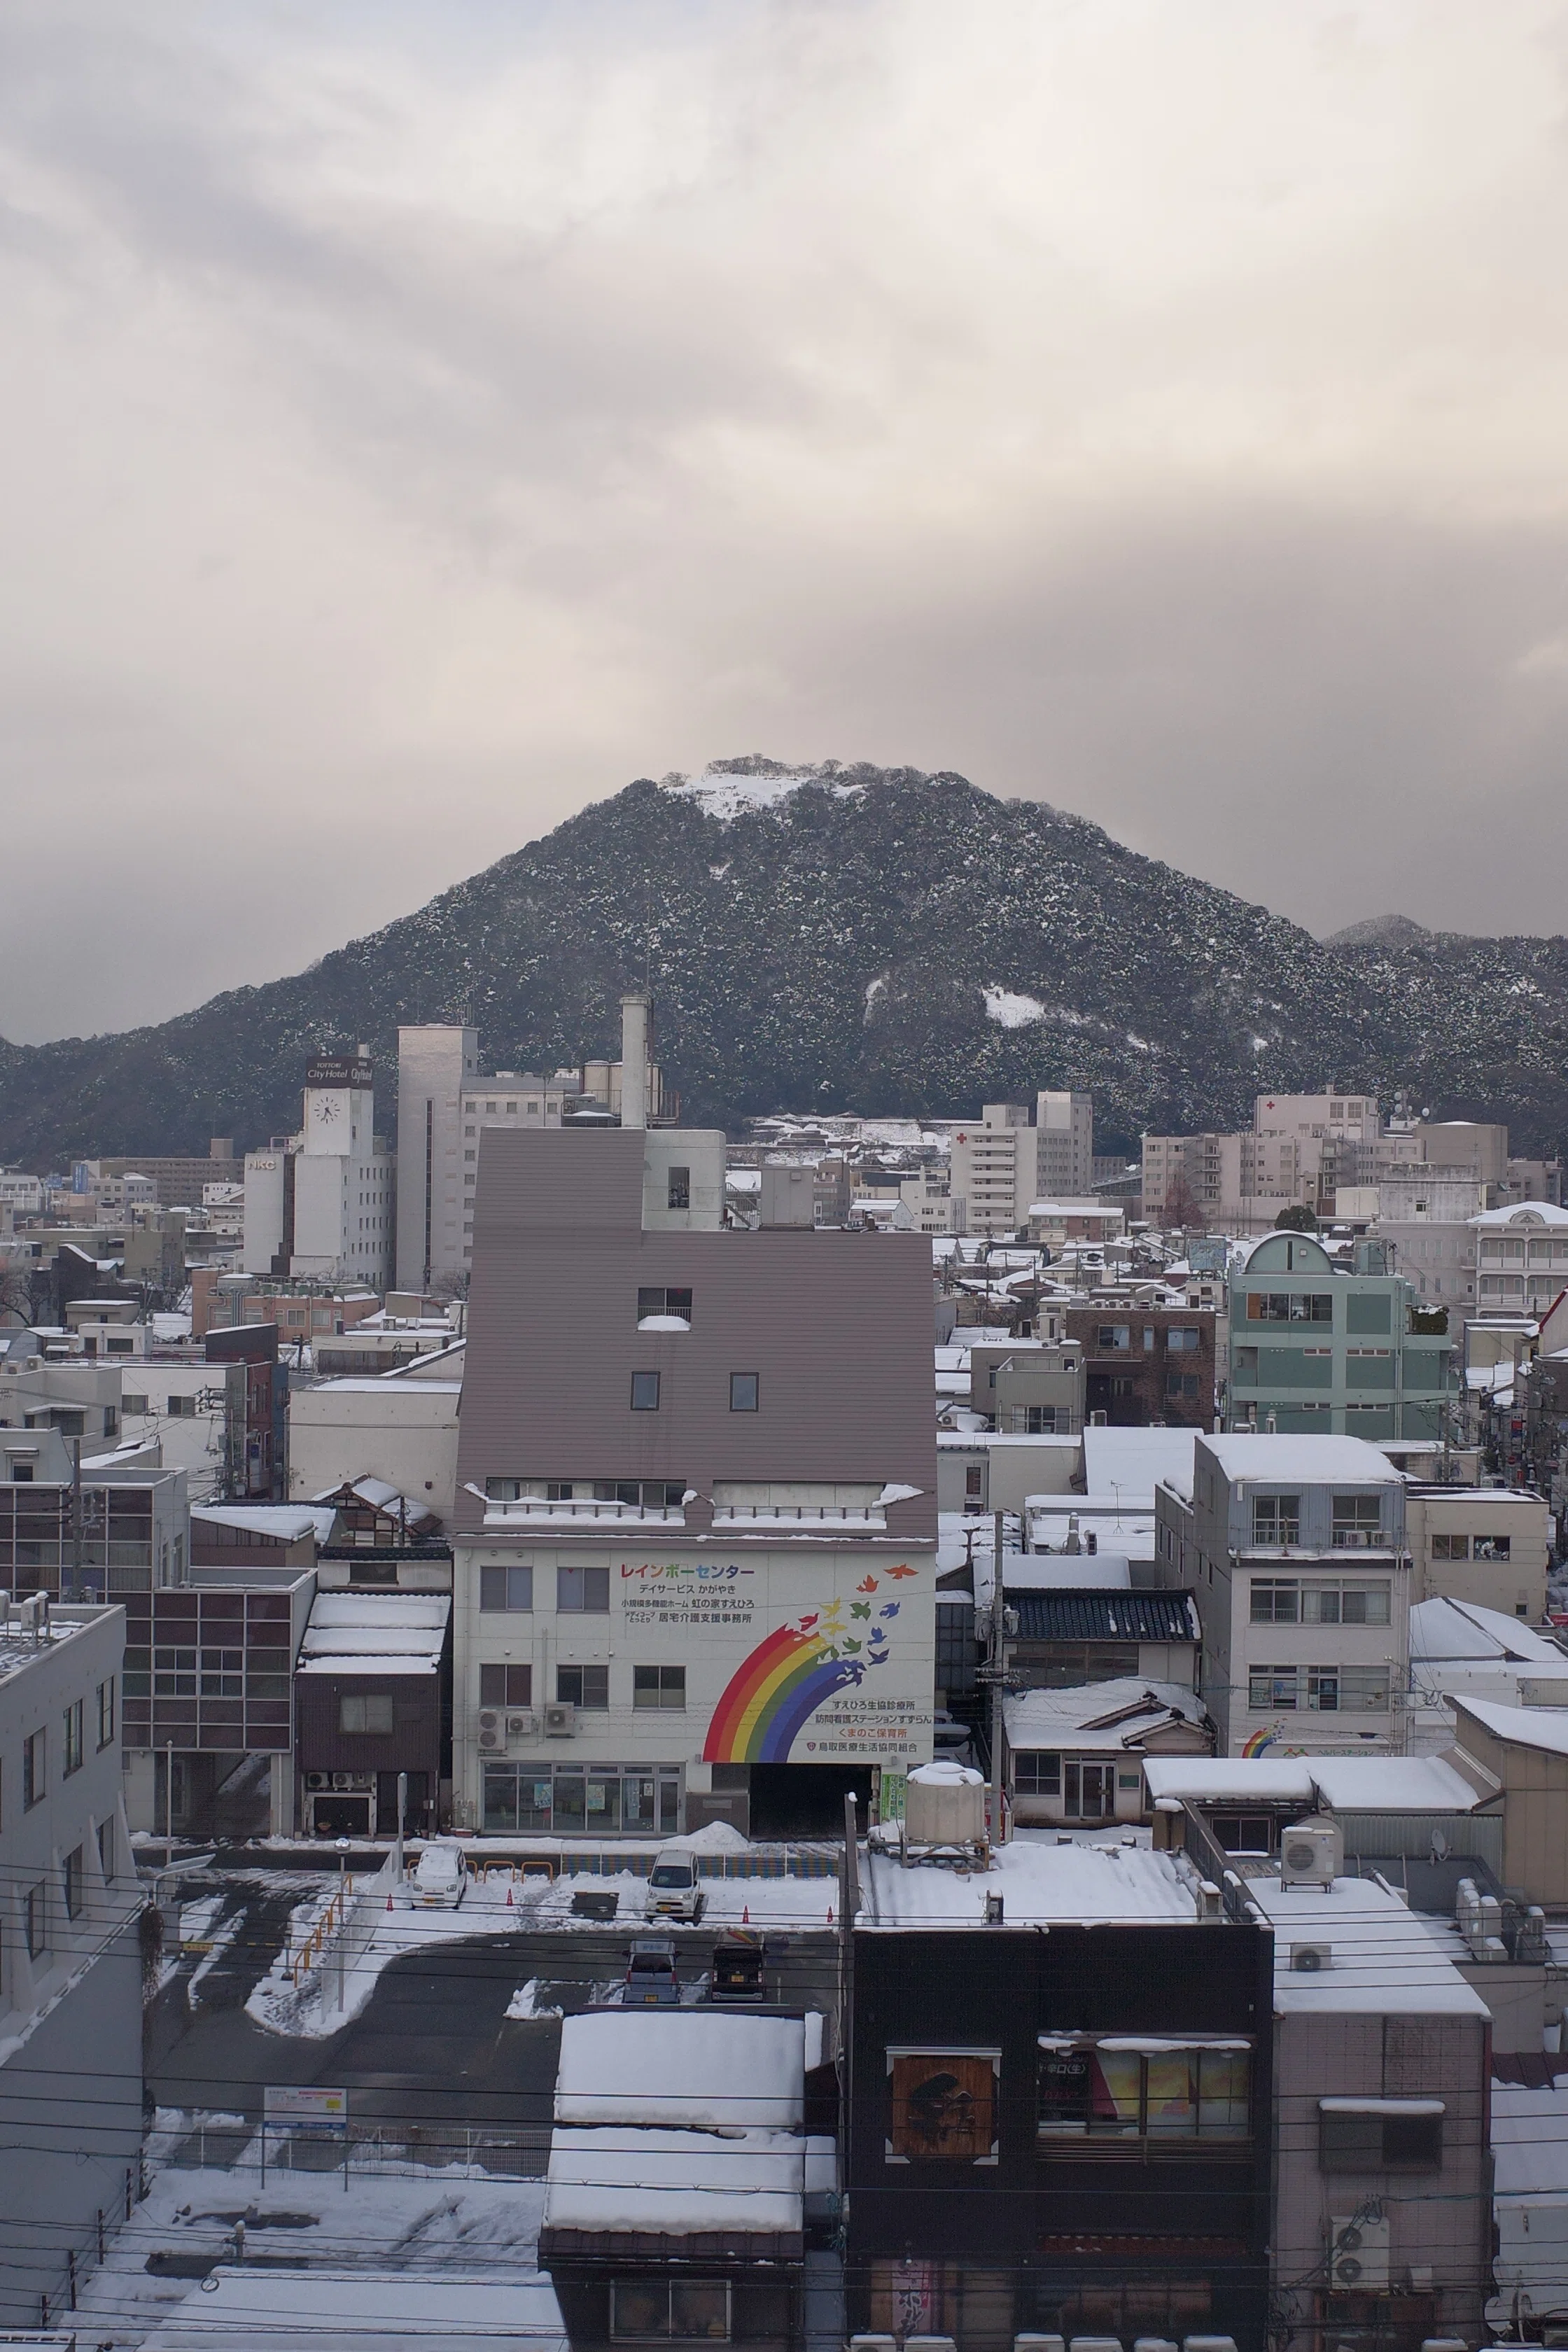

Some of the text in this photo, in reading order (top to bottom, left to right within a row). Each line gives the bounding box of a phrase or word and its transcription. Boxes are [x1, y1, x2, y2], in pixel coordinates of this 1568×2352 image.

[307, 1069, 348, 1080] City Hotel
[248, 1160, 276, 1170] NKC
[621, 1564, 755, 1579] レインボーセンター
[639, 1583, 736, 1595] デイサービス かがやき
[622, 1598, 755, 1609] 小規模多機能ホーム 虹の家すえひろ
[659, 1612, 752, 1623] 居宅介護支援事務所
[832, 1700, 916, 1711] すえひろ生協診療所
[838, 1728, 908, 1738] くまのこ保育所
[818, 1742, 918, 1752] 鳥取医療生活協同組合
